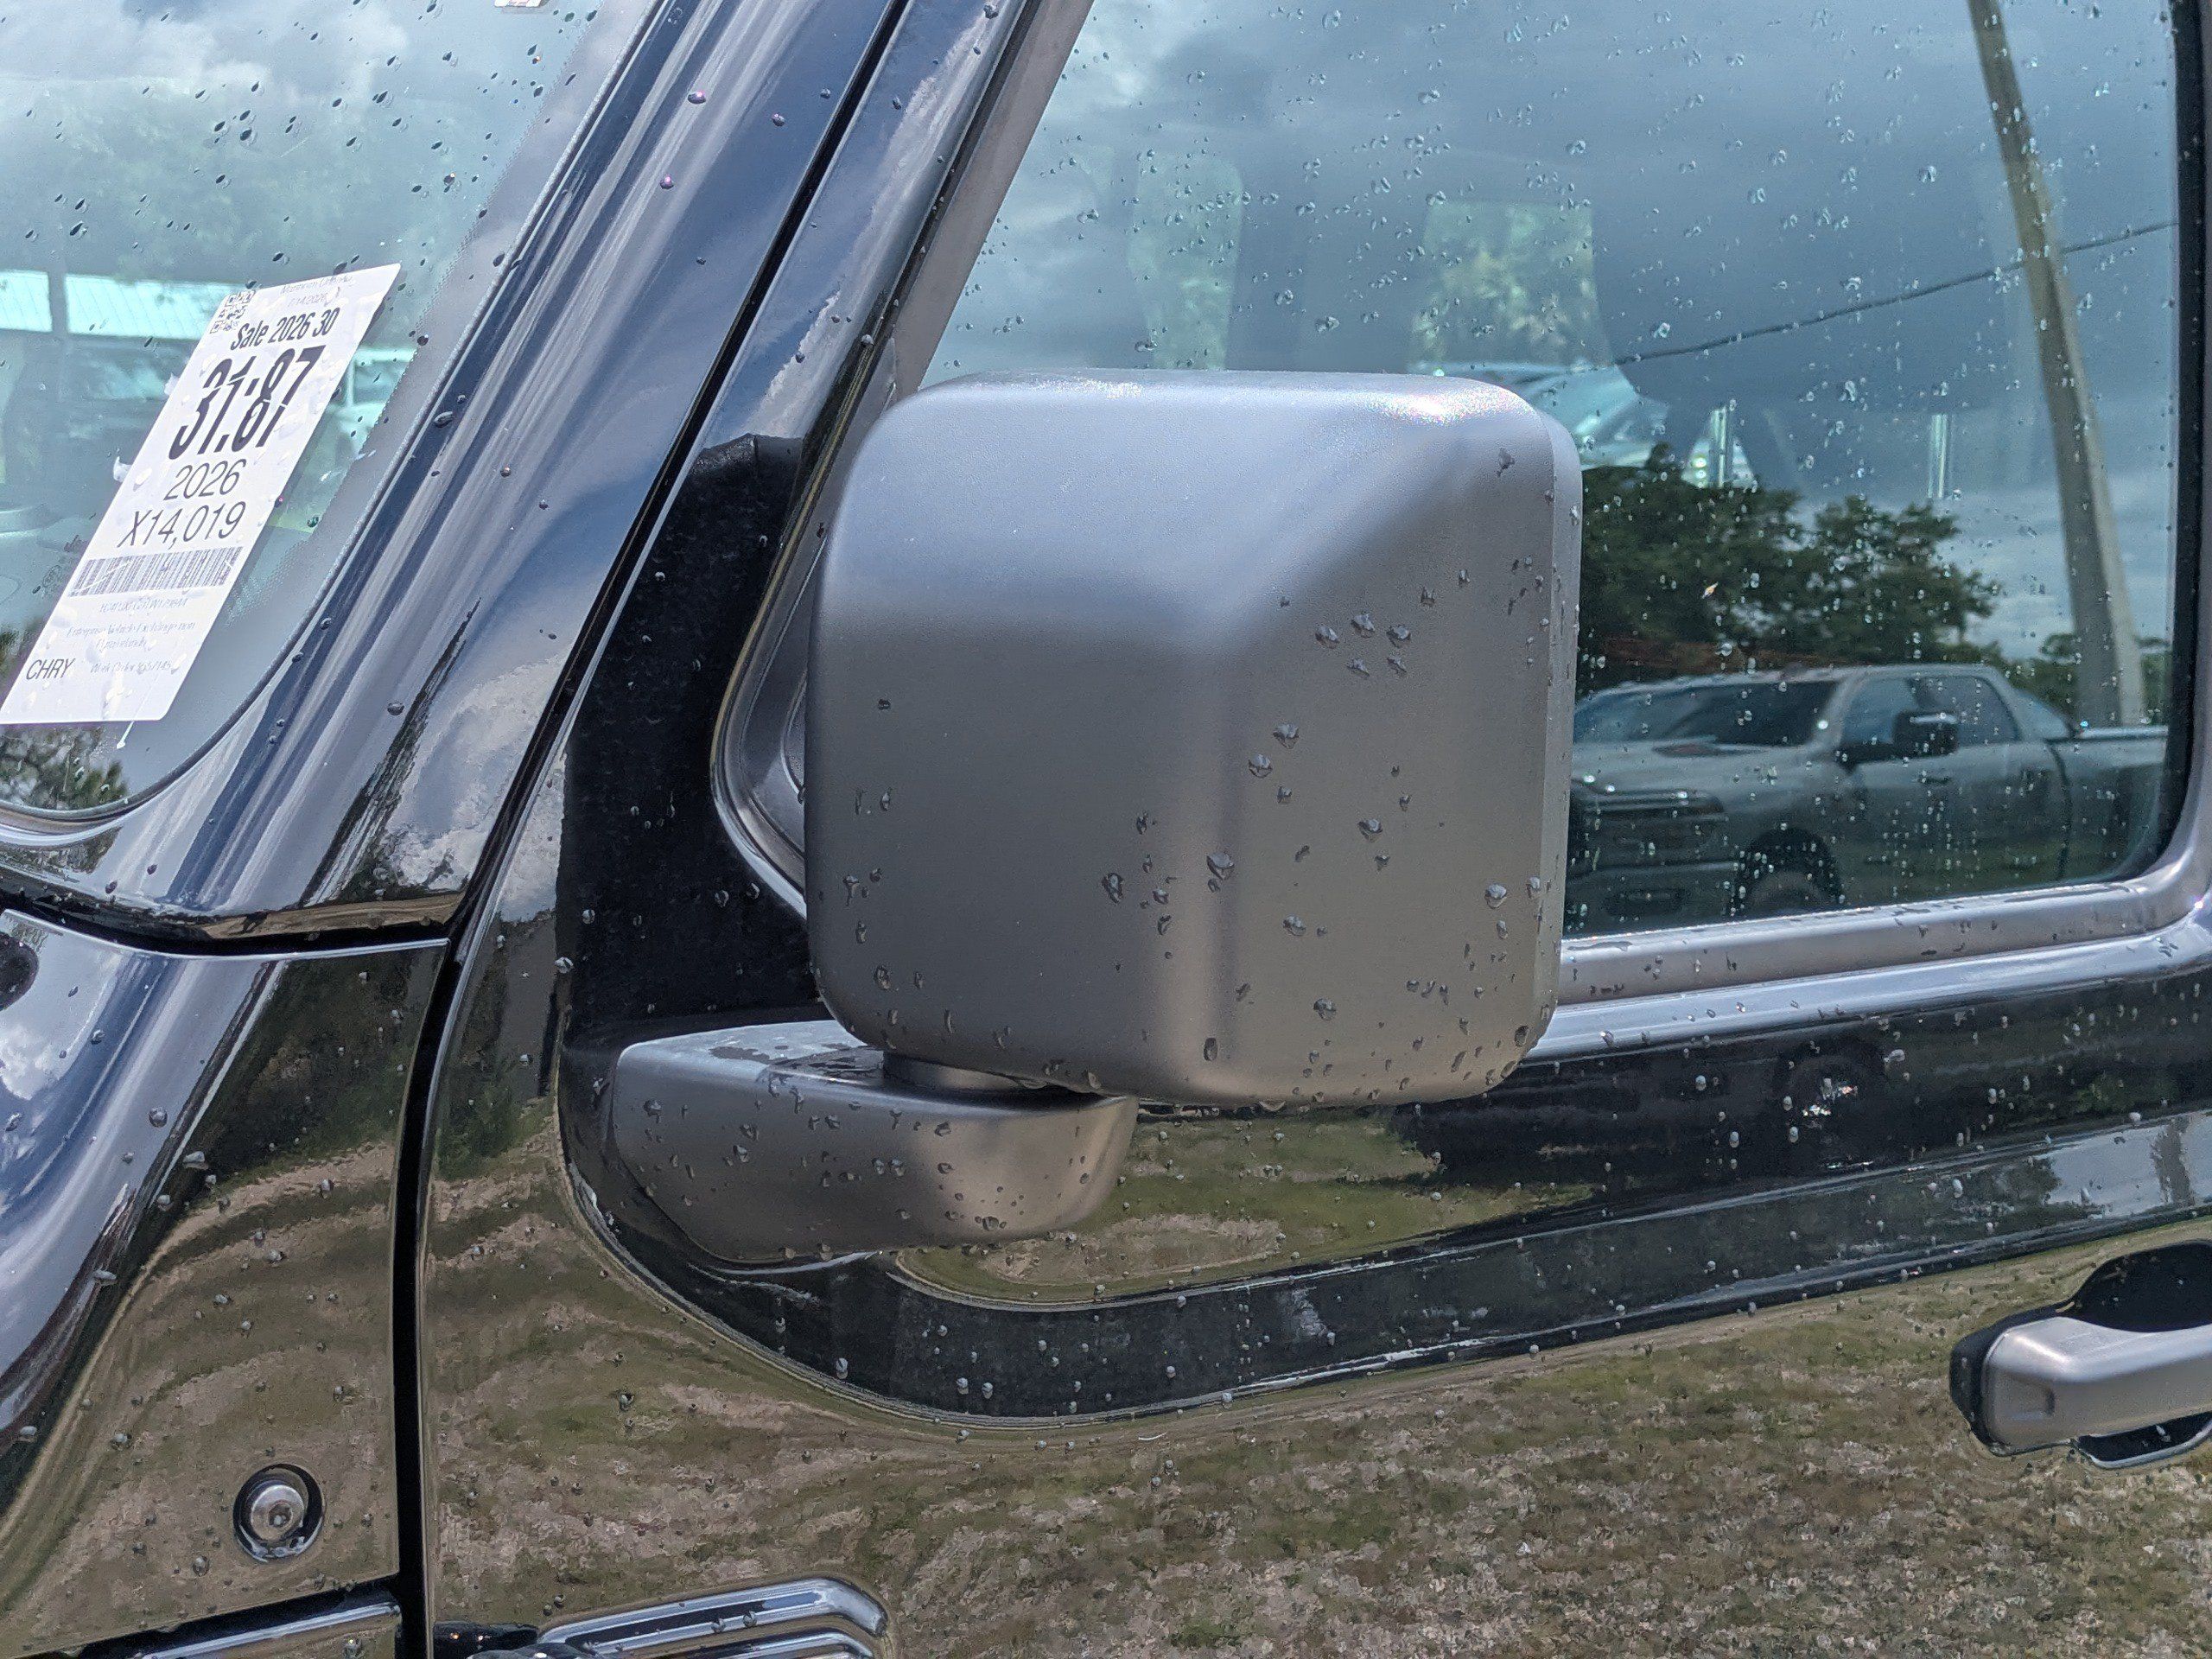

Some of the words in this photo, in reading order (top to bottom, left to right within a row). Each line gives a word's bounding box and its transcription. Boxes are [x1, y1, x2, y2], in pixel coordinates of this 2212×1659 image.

[230, 320, 270, 351] Sale
[267, 312, 316, 344] 2026
[312, 307, 340, 338] 30
[168, 345, 326, 460] 31:87
[163, 459, 247, 501] 2026
[117, 501, 246, 550] X14,019
[26, 658, 75, 680] CHRY
